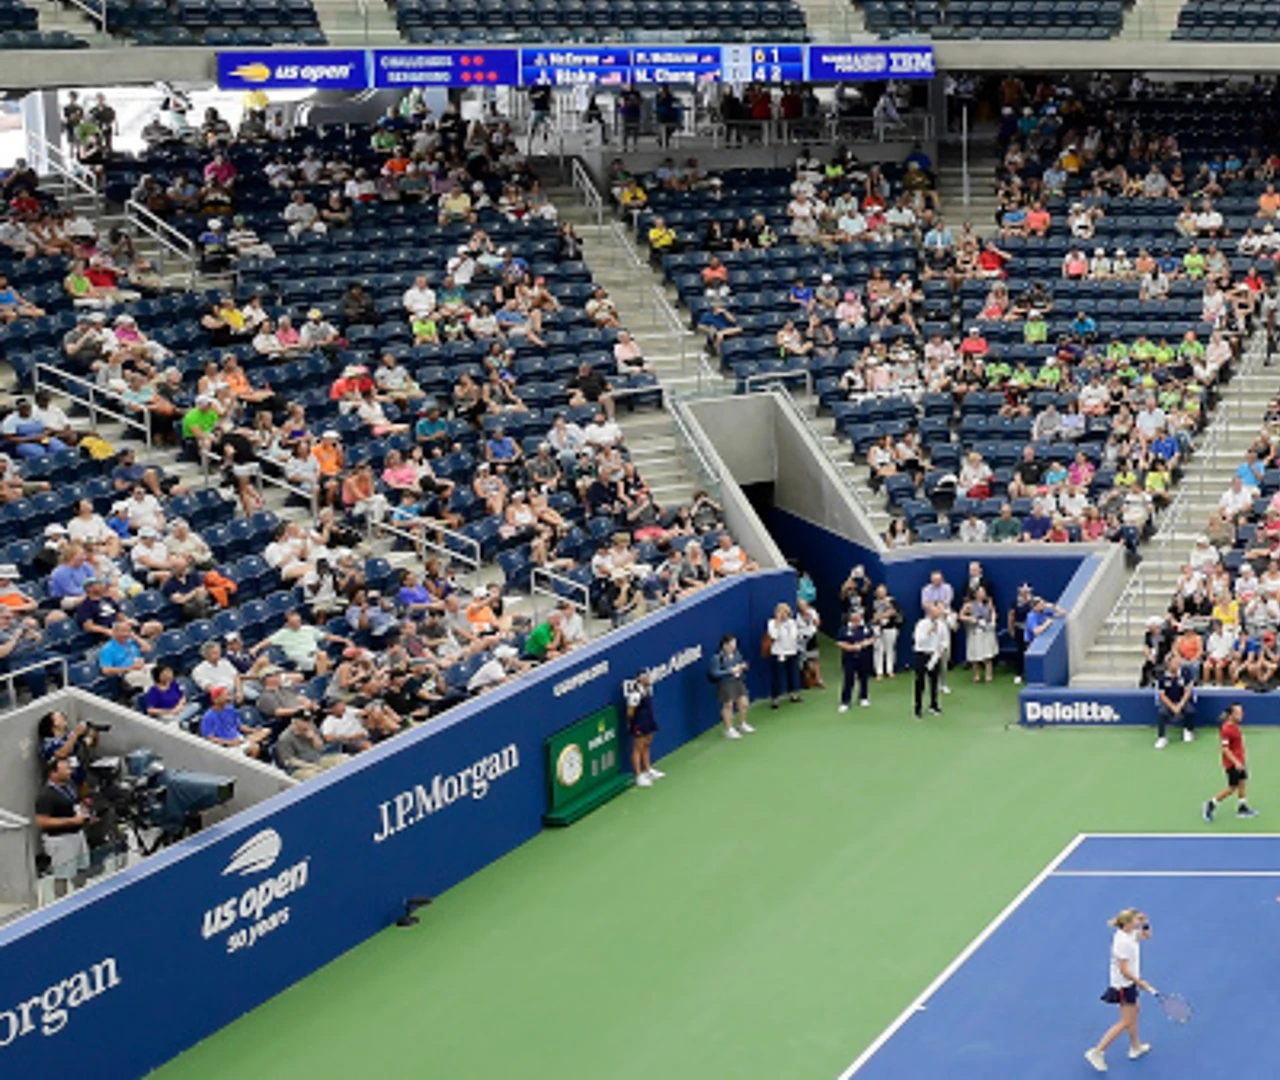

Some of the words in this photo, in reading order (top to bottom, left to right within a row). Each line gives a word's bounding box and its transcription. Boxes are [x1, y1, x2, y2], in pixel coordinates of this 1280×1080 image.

[770, 49, 779, 63] 1
[889, 52, 935, 73] IBM
[276, 65, 298, 80] us
[301, 64, 350, 82] open
[373, 743, 519, 843] J.P.Morgan
[202, 897, 238, 939] us
[239, 860, 308, 920] open
